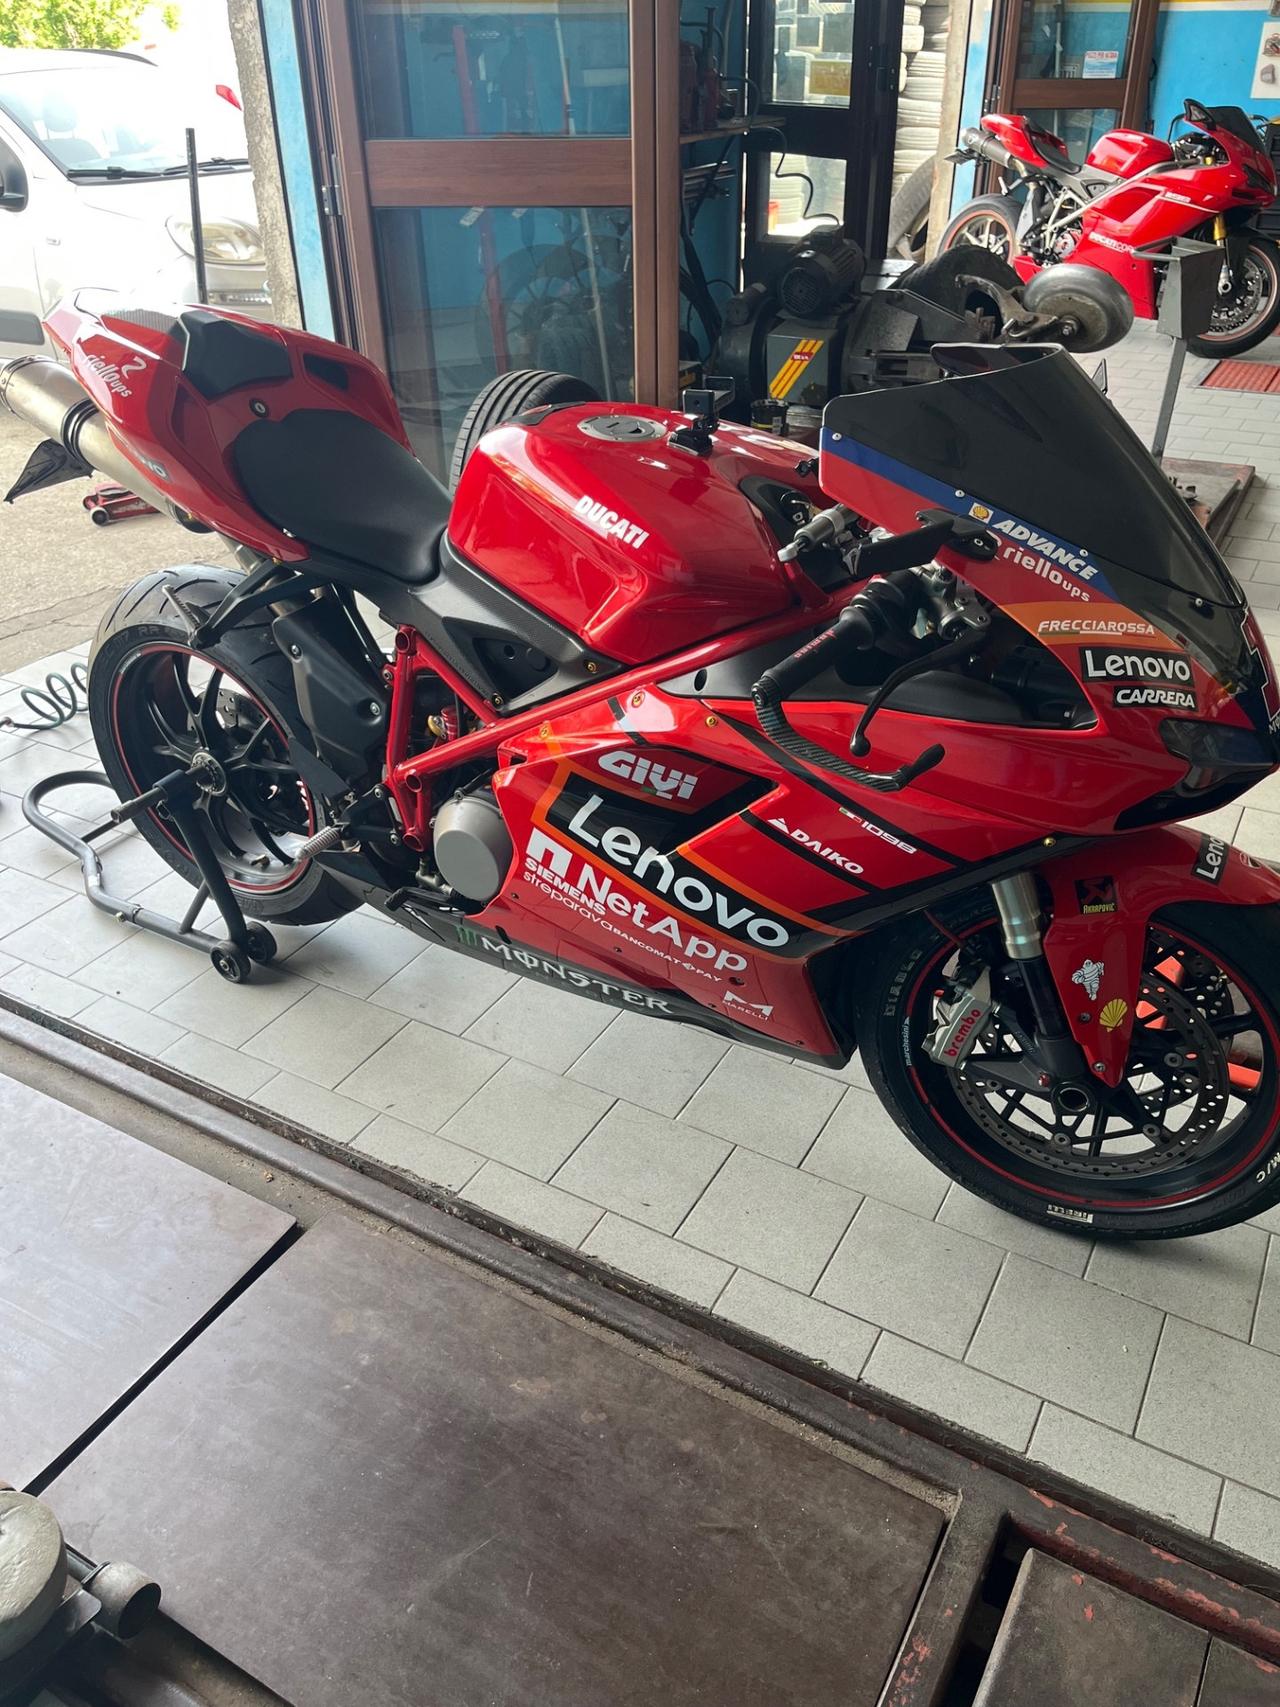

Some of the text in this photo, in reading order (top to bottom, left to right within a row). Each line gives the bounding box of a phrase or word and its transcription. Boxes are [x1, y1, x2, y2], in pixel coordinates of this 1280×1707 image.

[574, 495, 650, 549] DUCATI
[993, 519, 1099, 580] ADVANCE
[1038, 620, 1155, 635] FRECCIAROSSA
[1085, 650, 1190, 681] Lenovo
[1116, 689, 1196, 708] CARRERA
[598, 751, 698, 800] GIVI
[568, 794, 789, 946] Lenovo
[790, 828, 864, 874] DAIKO
[523, 871, 614, 931] streparava
[525, 857, 607, 917] SIEMENS
[576, 862, 747, 971] NetApp
[481, 937, 674, 1014] MONSTER
[613, 928, 722, 982] BANCOMAT PAY
[944, 1009, 981, 1057] brembo
